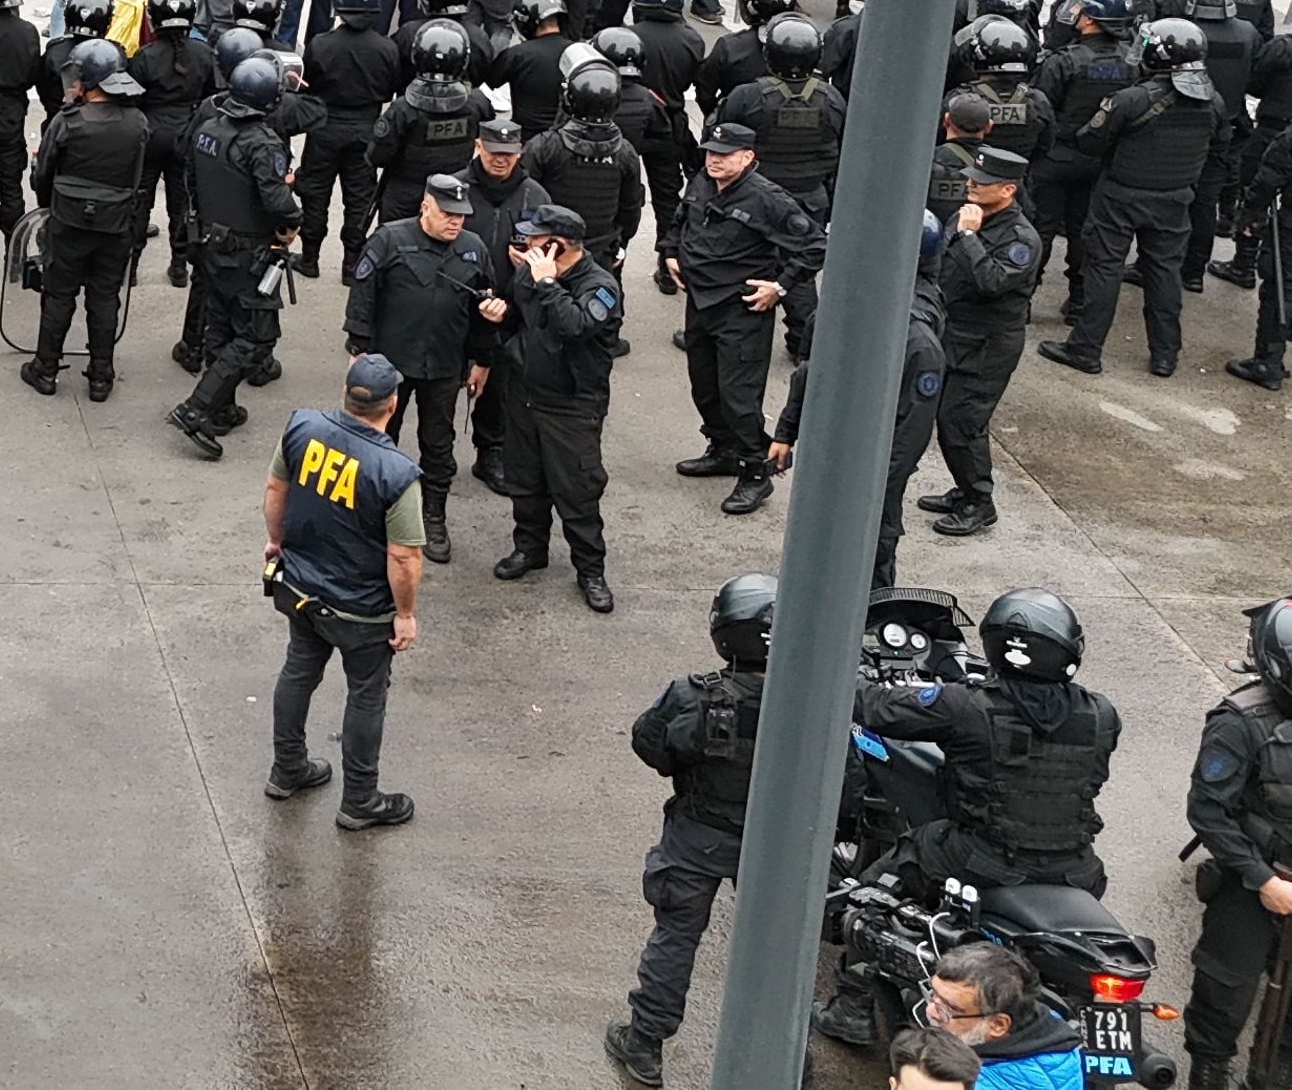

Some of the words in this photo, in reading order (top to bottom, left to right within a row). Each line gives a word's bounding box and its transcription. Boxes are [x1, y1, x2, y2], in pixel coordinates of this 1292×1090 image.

[991, 106, 1019, 120] PFA
[434, 124, 465, 137] PFA
[938, 183, 966, 197] PF
[298, 439, 360, 509] PFA
[1094, 1010, 1127, 1031] 791
[1095, 1029, 1132, 1050] ETM
[1085, 1054, 1133, 1075] PFA
